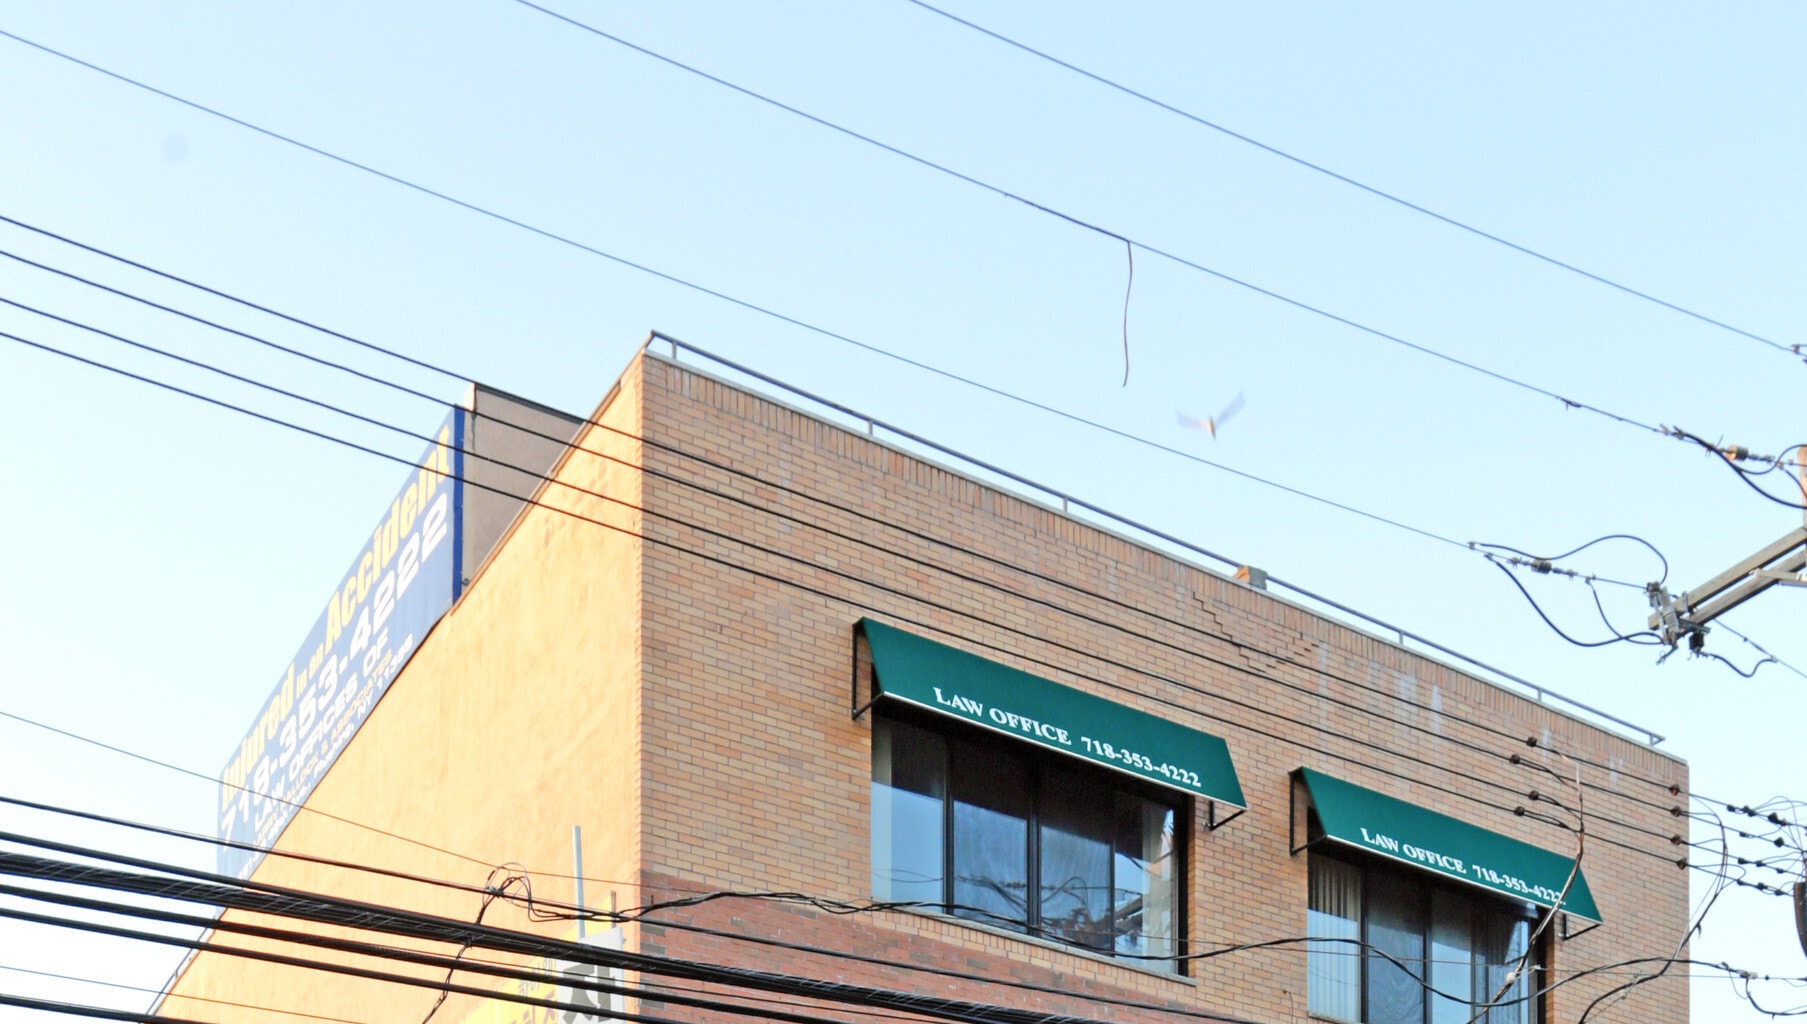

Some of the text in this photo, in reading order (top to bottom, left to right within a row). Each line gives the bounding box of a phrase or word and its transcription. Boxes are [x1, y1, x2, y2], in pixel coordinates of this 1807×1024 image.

[325, 424, 450, 656] Accident
[255, 626, 388, 832] LAW OFFICES OF
[933, 687, 1202, 788] LAW OFFICE 718-353-4222
[1360, 827, 1399, 854] LAW
[1402, 843, 1467, 874] OFFICE
